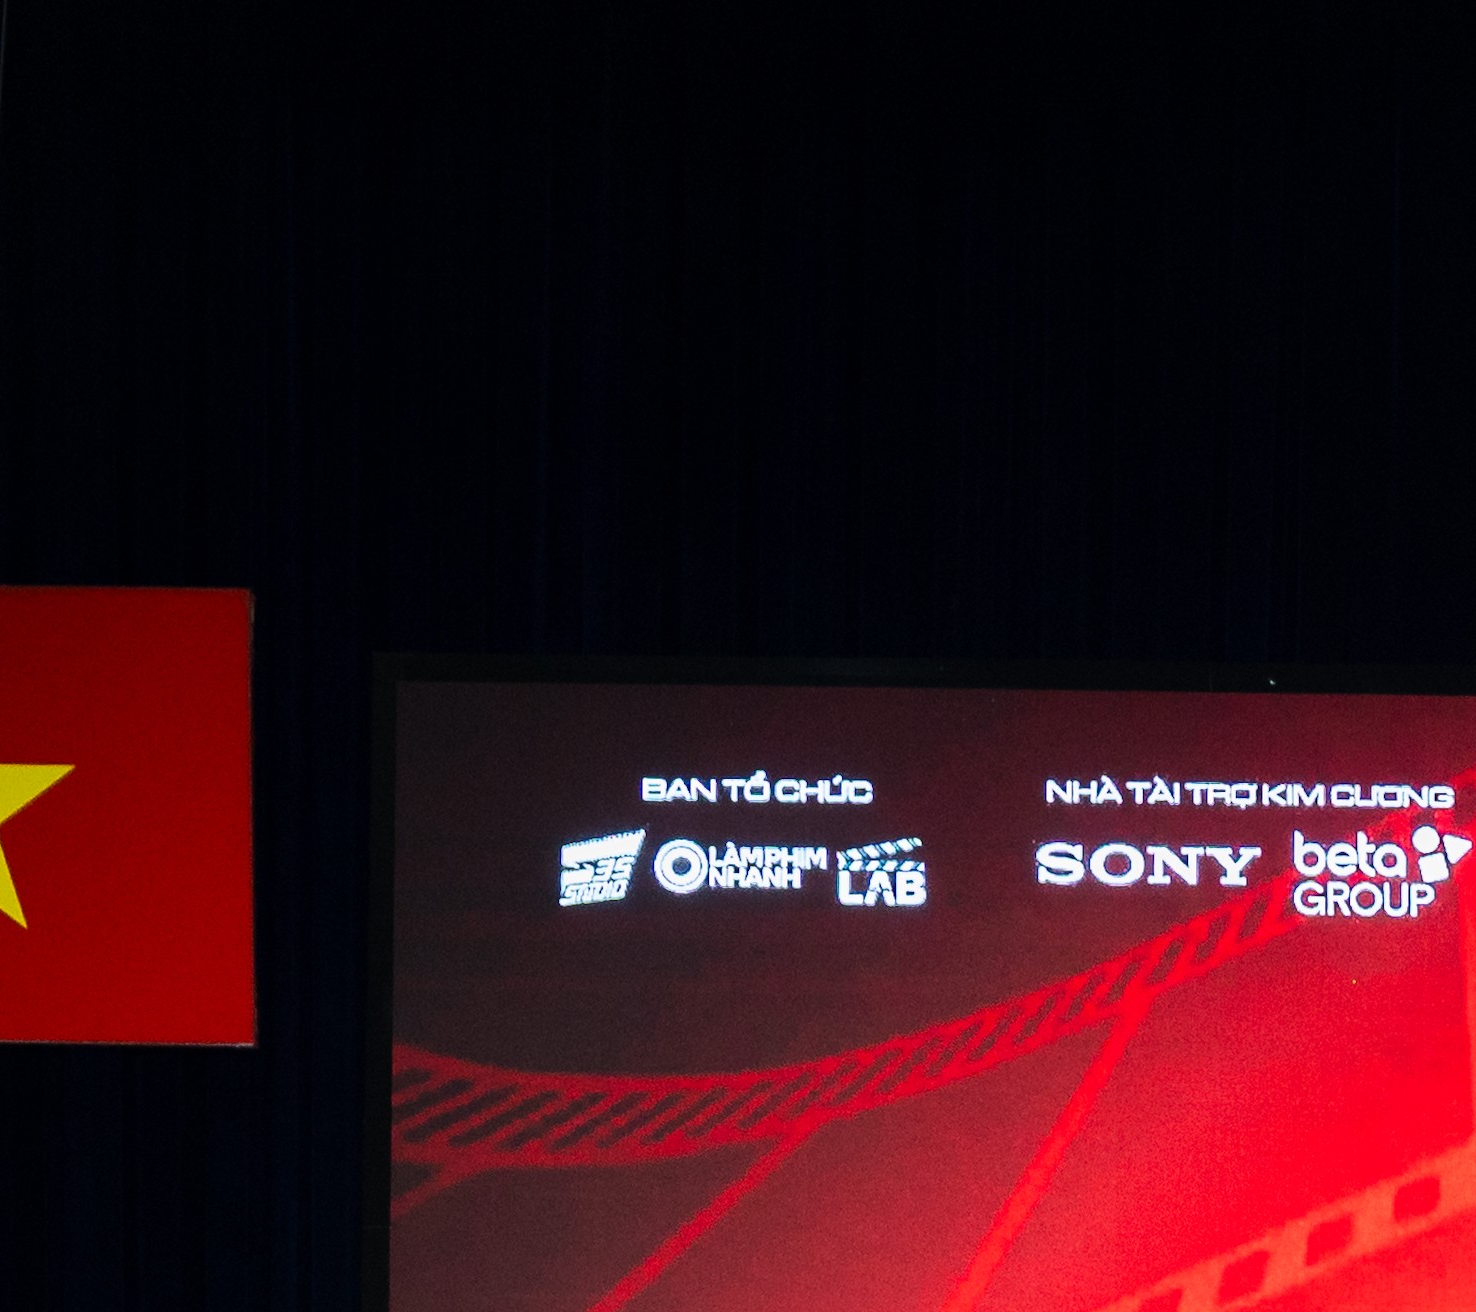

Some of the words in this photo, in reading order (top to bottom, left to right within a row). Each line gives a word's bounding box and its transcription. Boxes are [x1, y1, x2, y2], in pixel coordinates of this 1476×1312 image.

[641, 778, 717, 802] BAN
[721, 769, 771, 803] TỔ
[774, 773, 874, 805] CHỨC
[1045, 775, 1123, 804] NHÀ
[1126, 775, 1180, 806] TÀI
[1185, 782, 1261, 809] TRỢ
[1262, 783, 1325, 807] KIM
[709, 841, 766, 868] LÀM
[766, 846, 828, 870] PHIM
[1035, 842, 1262, 887] SONY
[1293, 830, 1407, 878] beta
[709, 867, 803, 889] NHANH
[838, 870, 927, 907] LAB
[1293, 881, 1435, 917] GROUP
